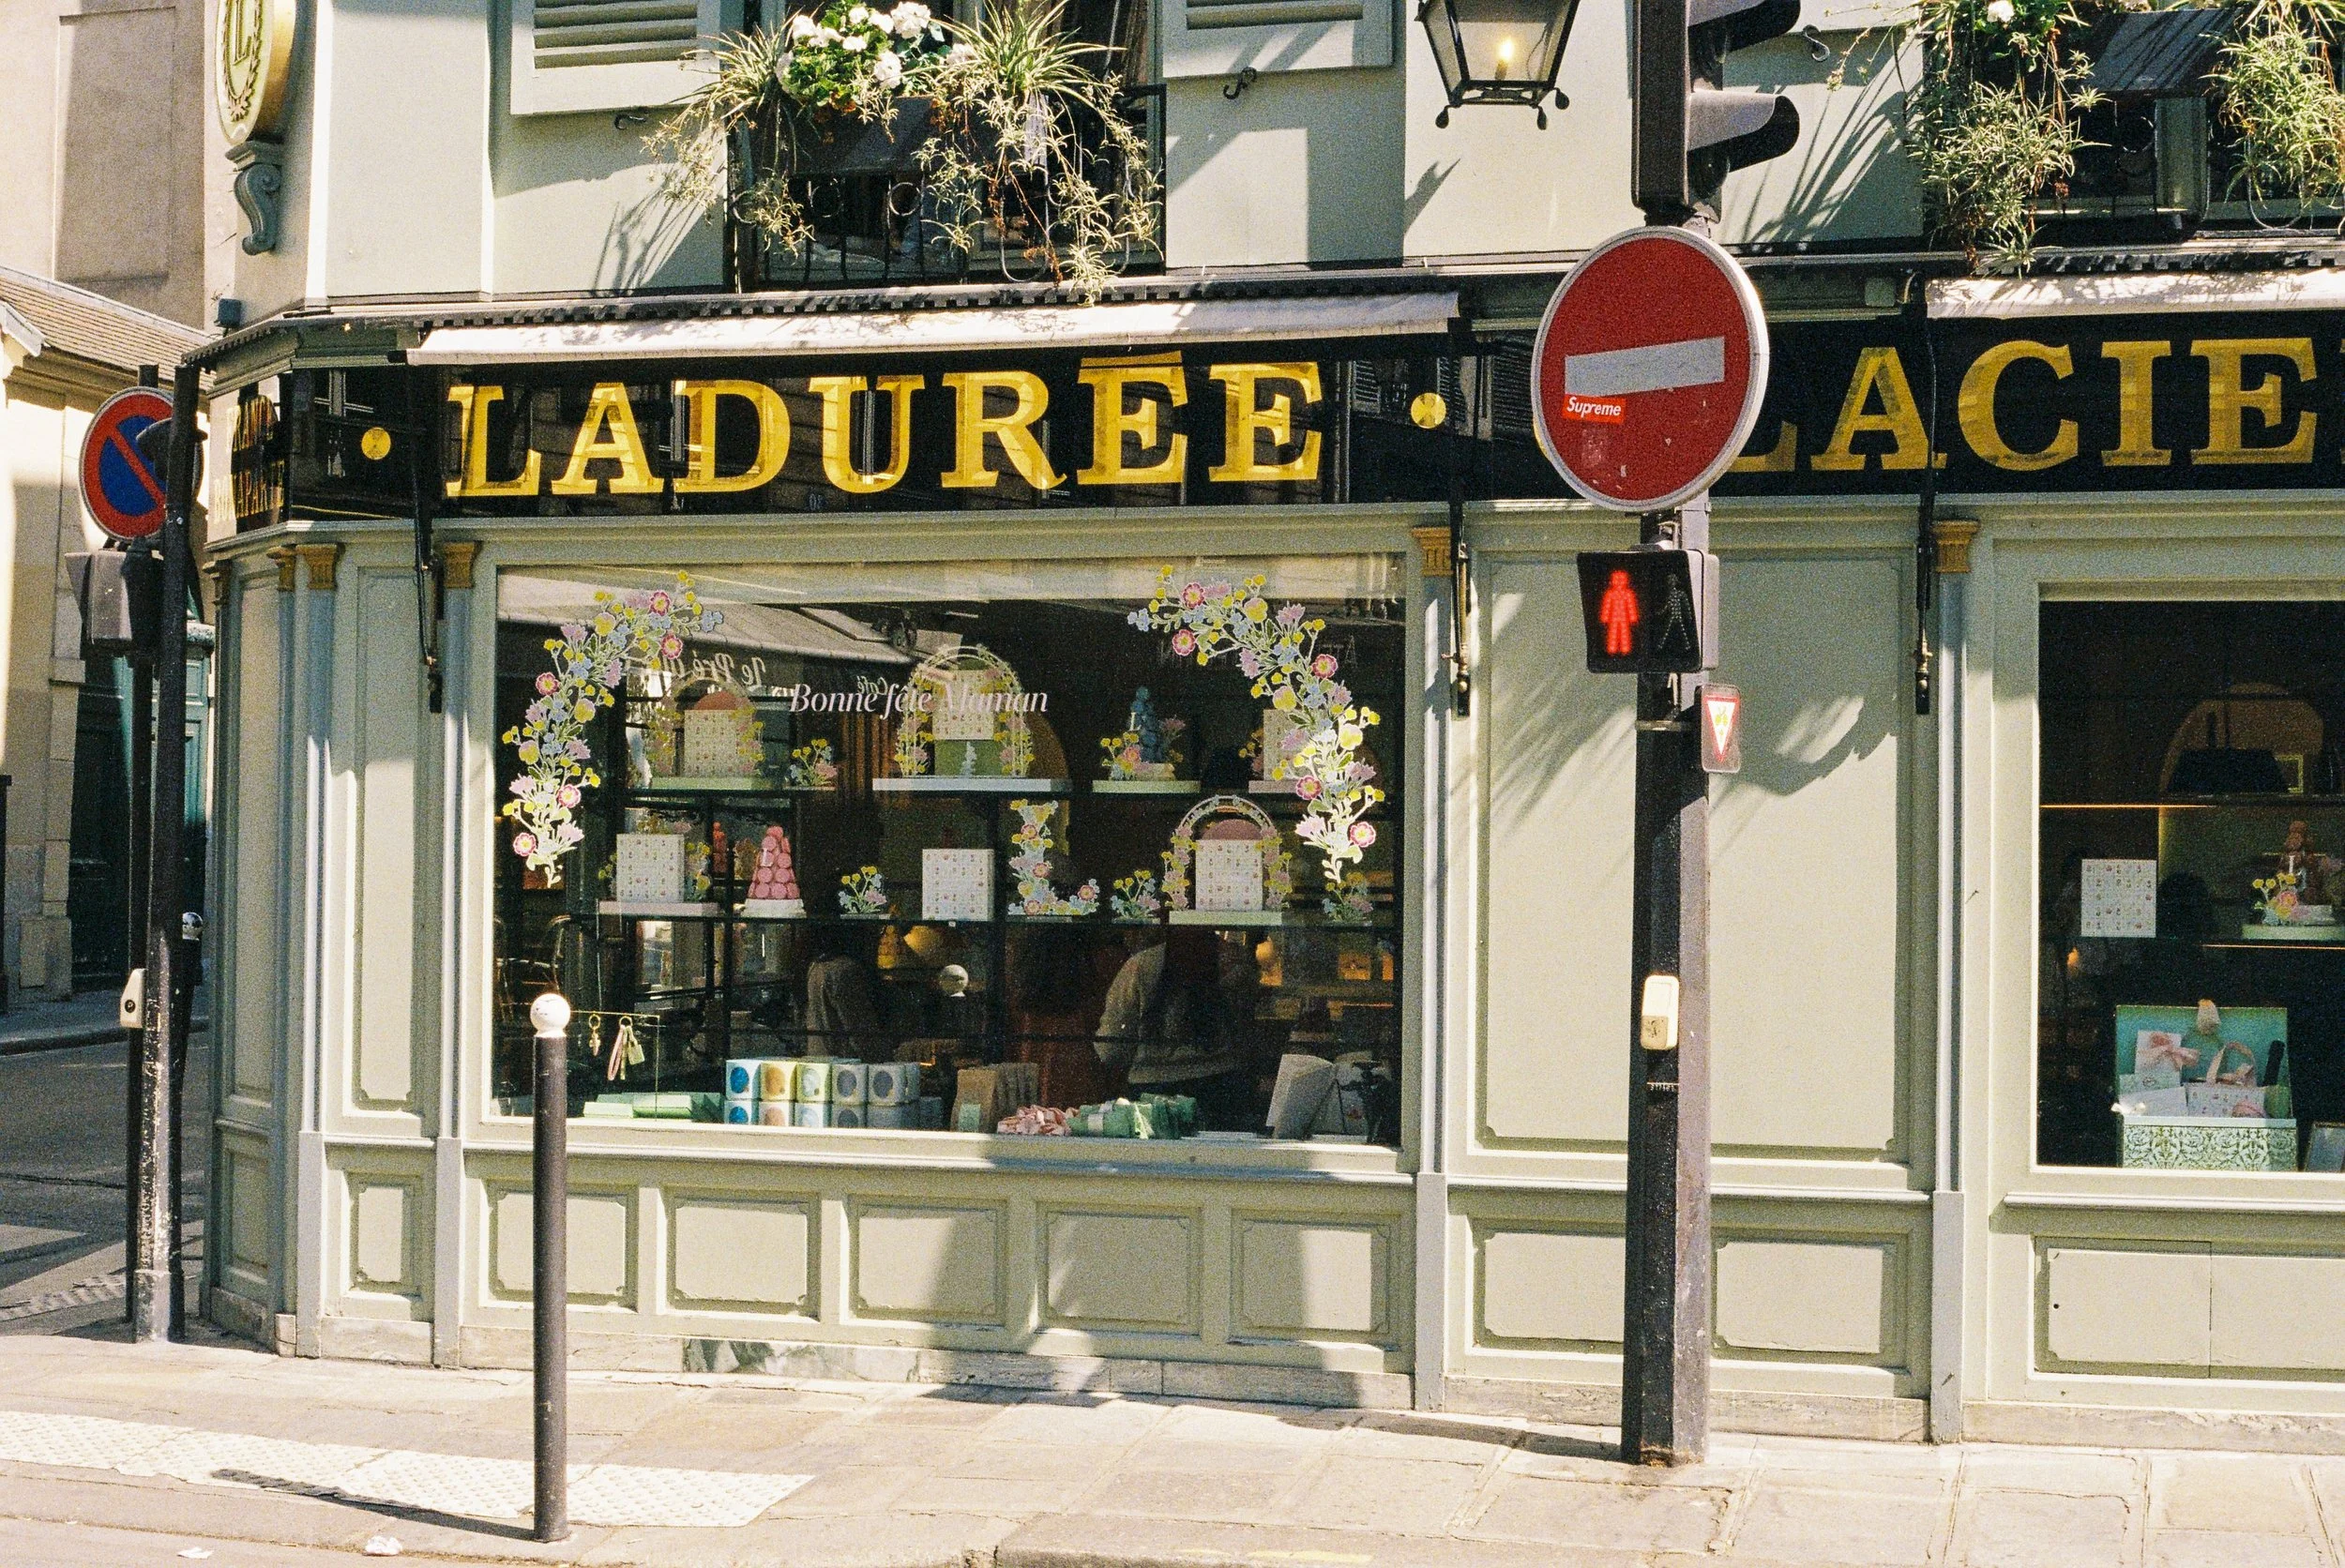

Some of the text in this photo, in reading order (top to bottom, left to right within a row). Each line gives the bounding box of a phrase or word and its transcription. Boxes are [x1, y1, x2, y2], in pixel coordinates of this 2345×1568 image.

[1566, 396, 1622, 418] Supreme
[789, 683, 878, 713] Bonne
[879, 684, 932, 720] fête
